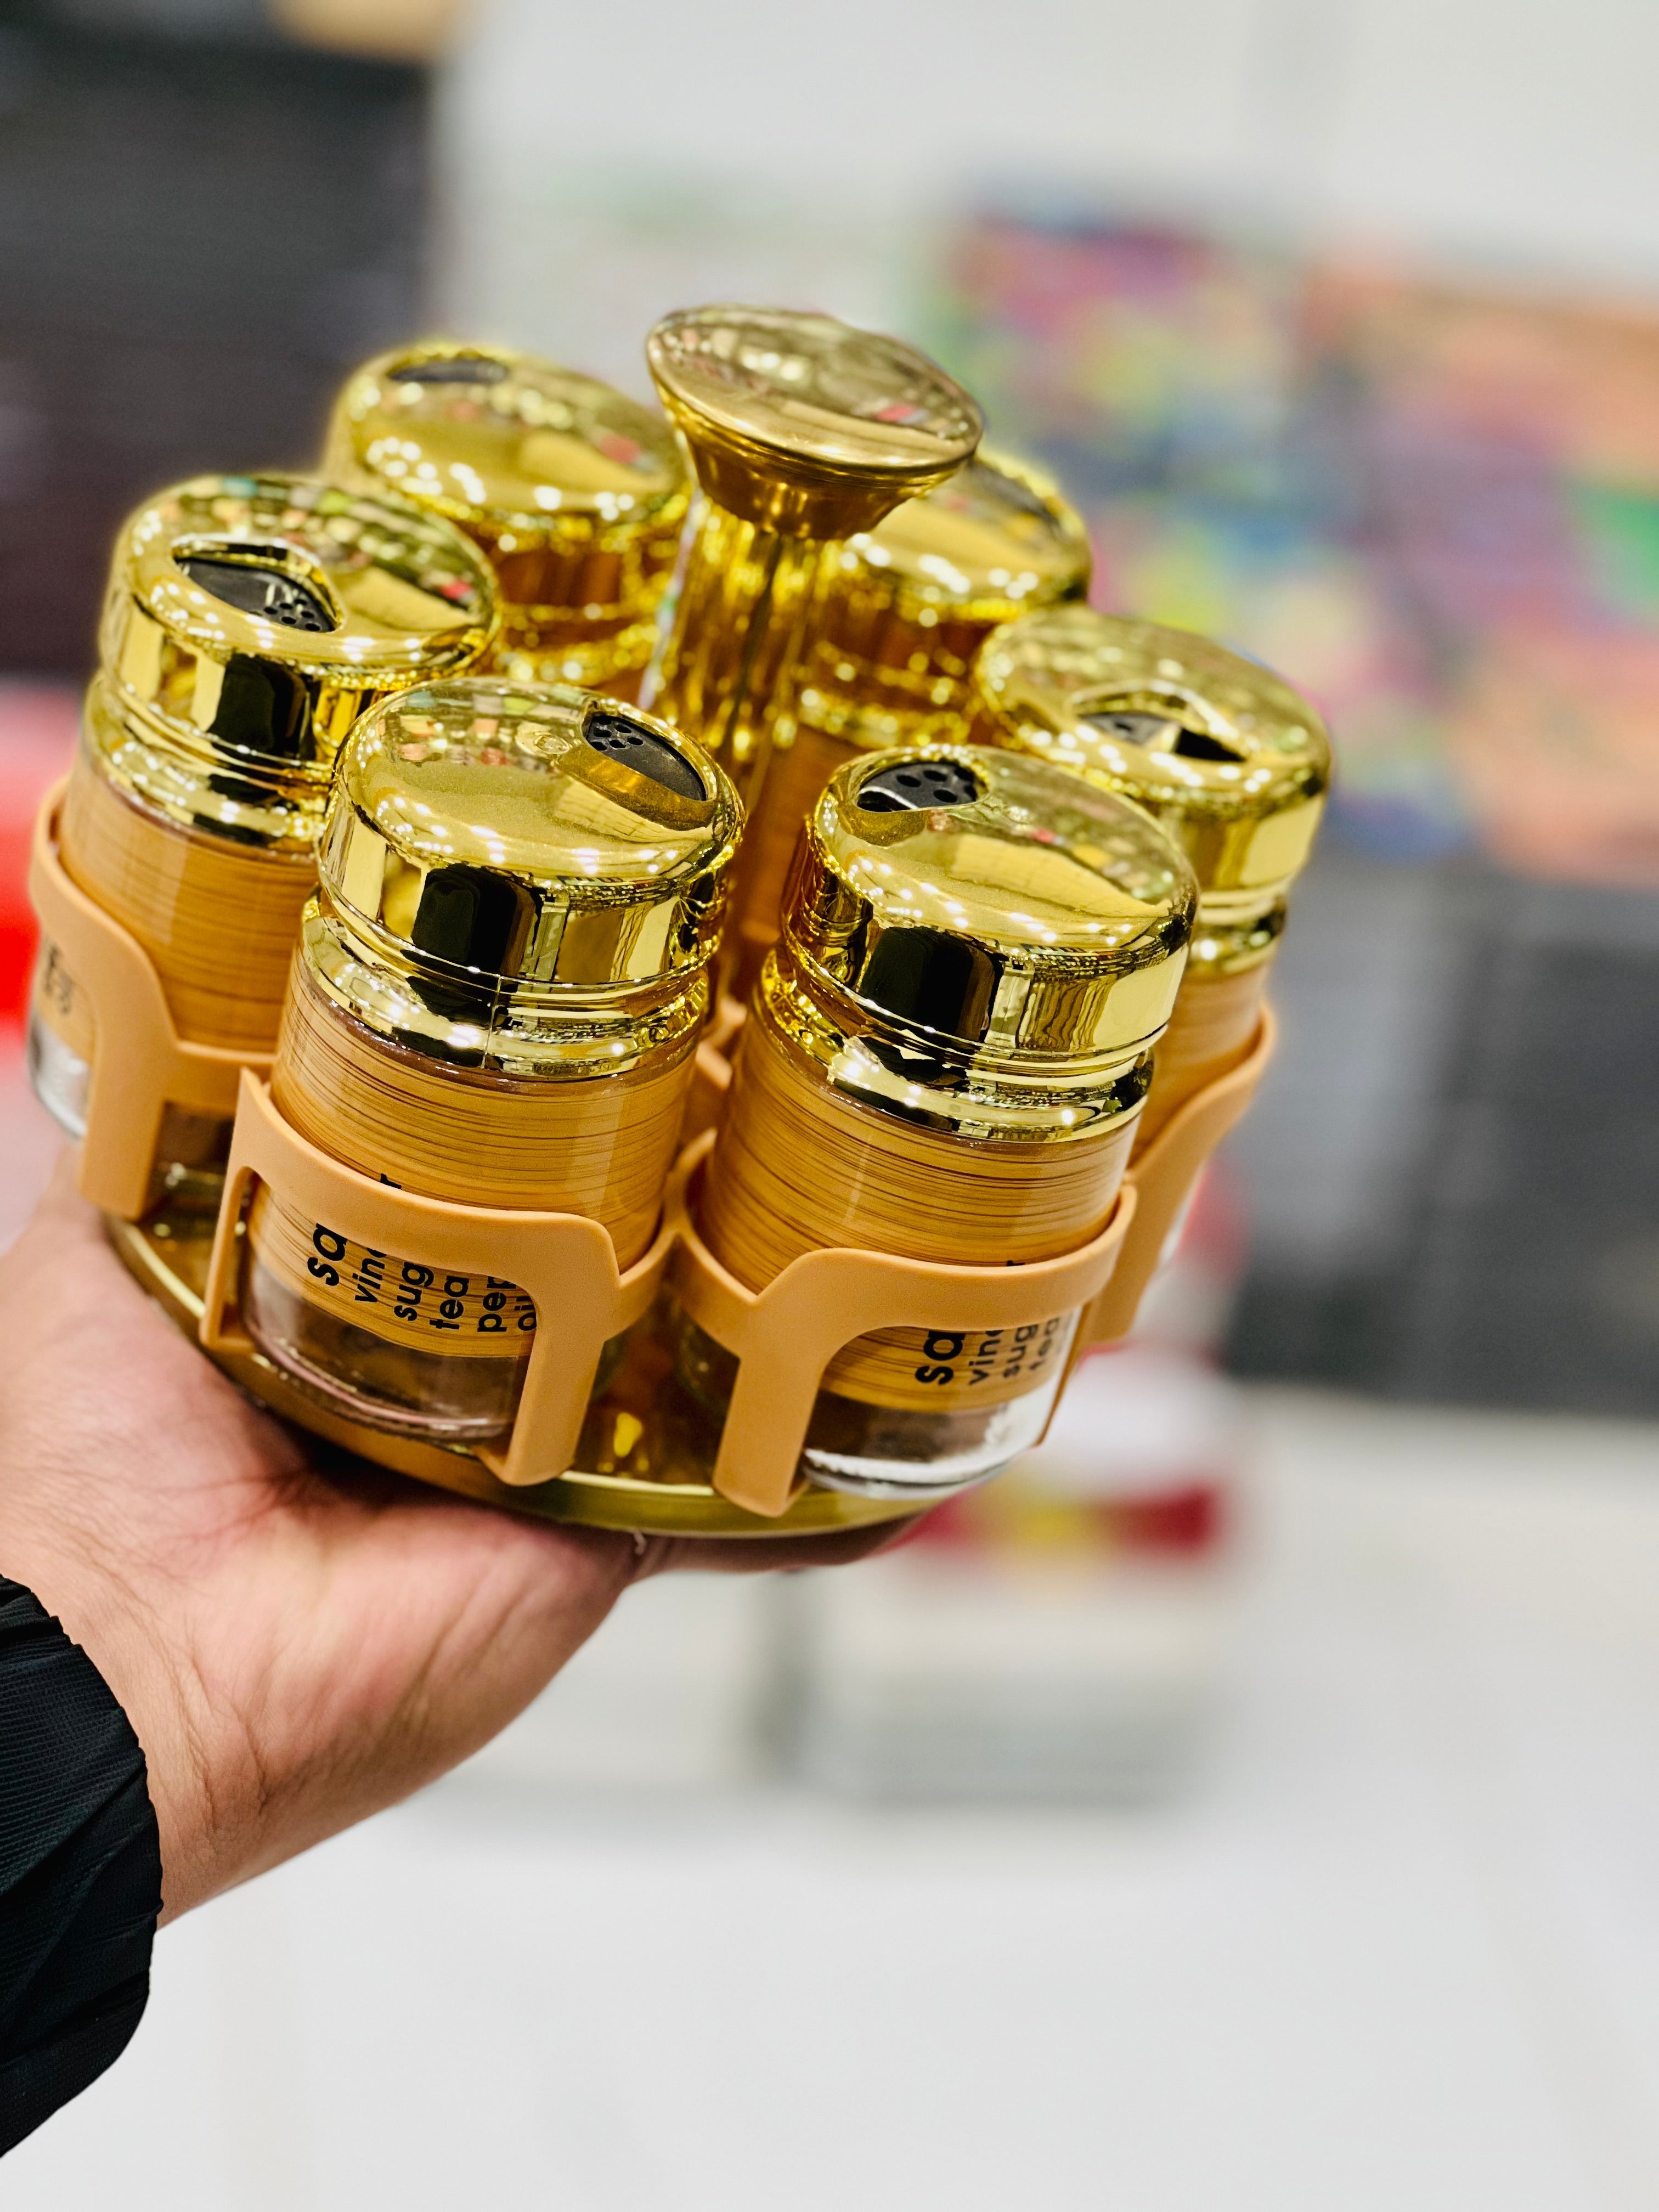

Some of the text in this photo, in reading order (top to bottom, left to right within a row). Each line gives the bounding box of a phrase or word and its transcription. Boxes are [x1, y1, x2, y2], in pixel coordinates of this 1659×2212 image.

[352, 1248, 386, 1302] vin
[430, 1276, 470, 1329] tea
[968, 1330, 1003, 1385] vin
